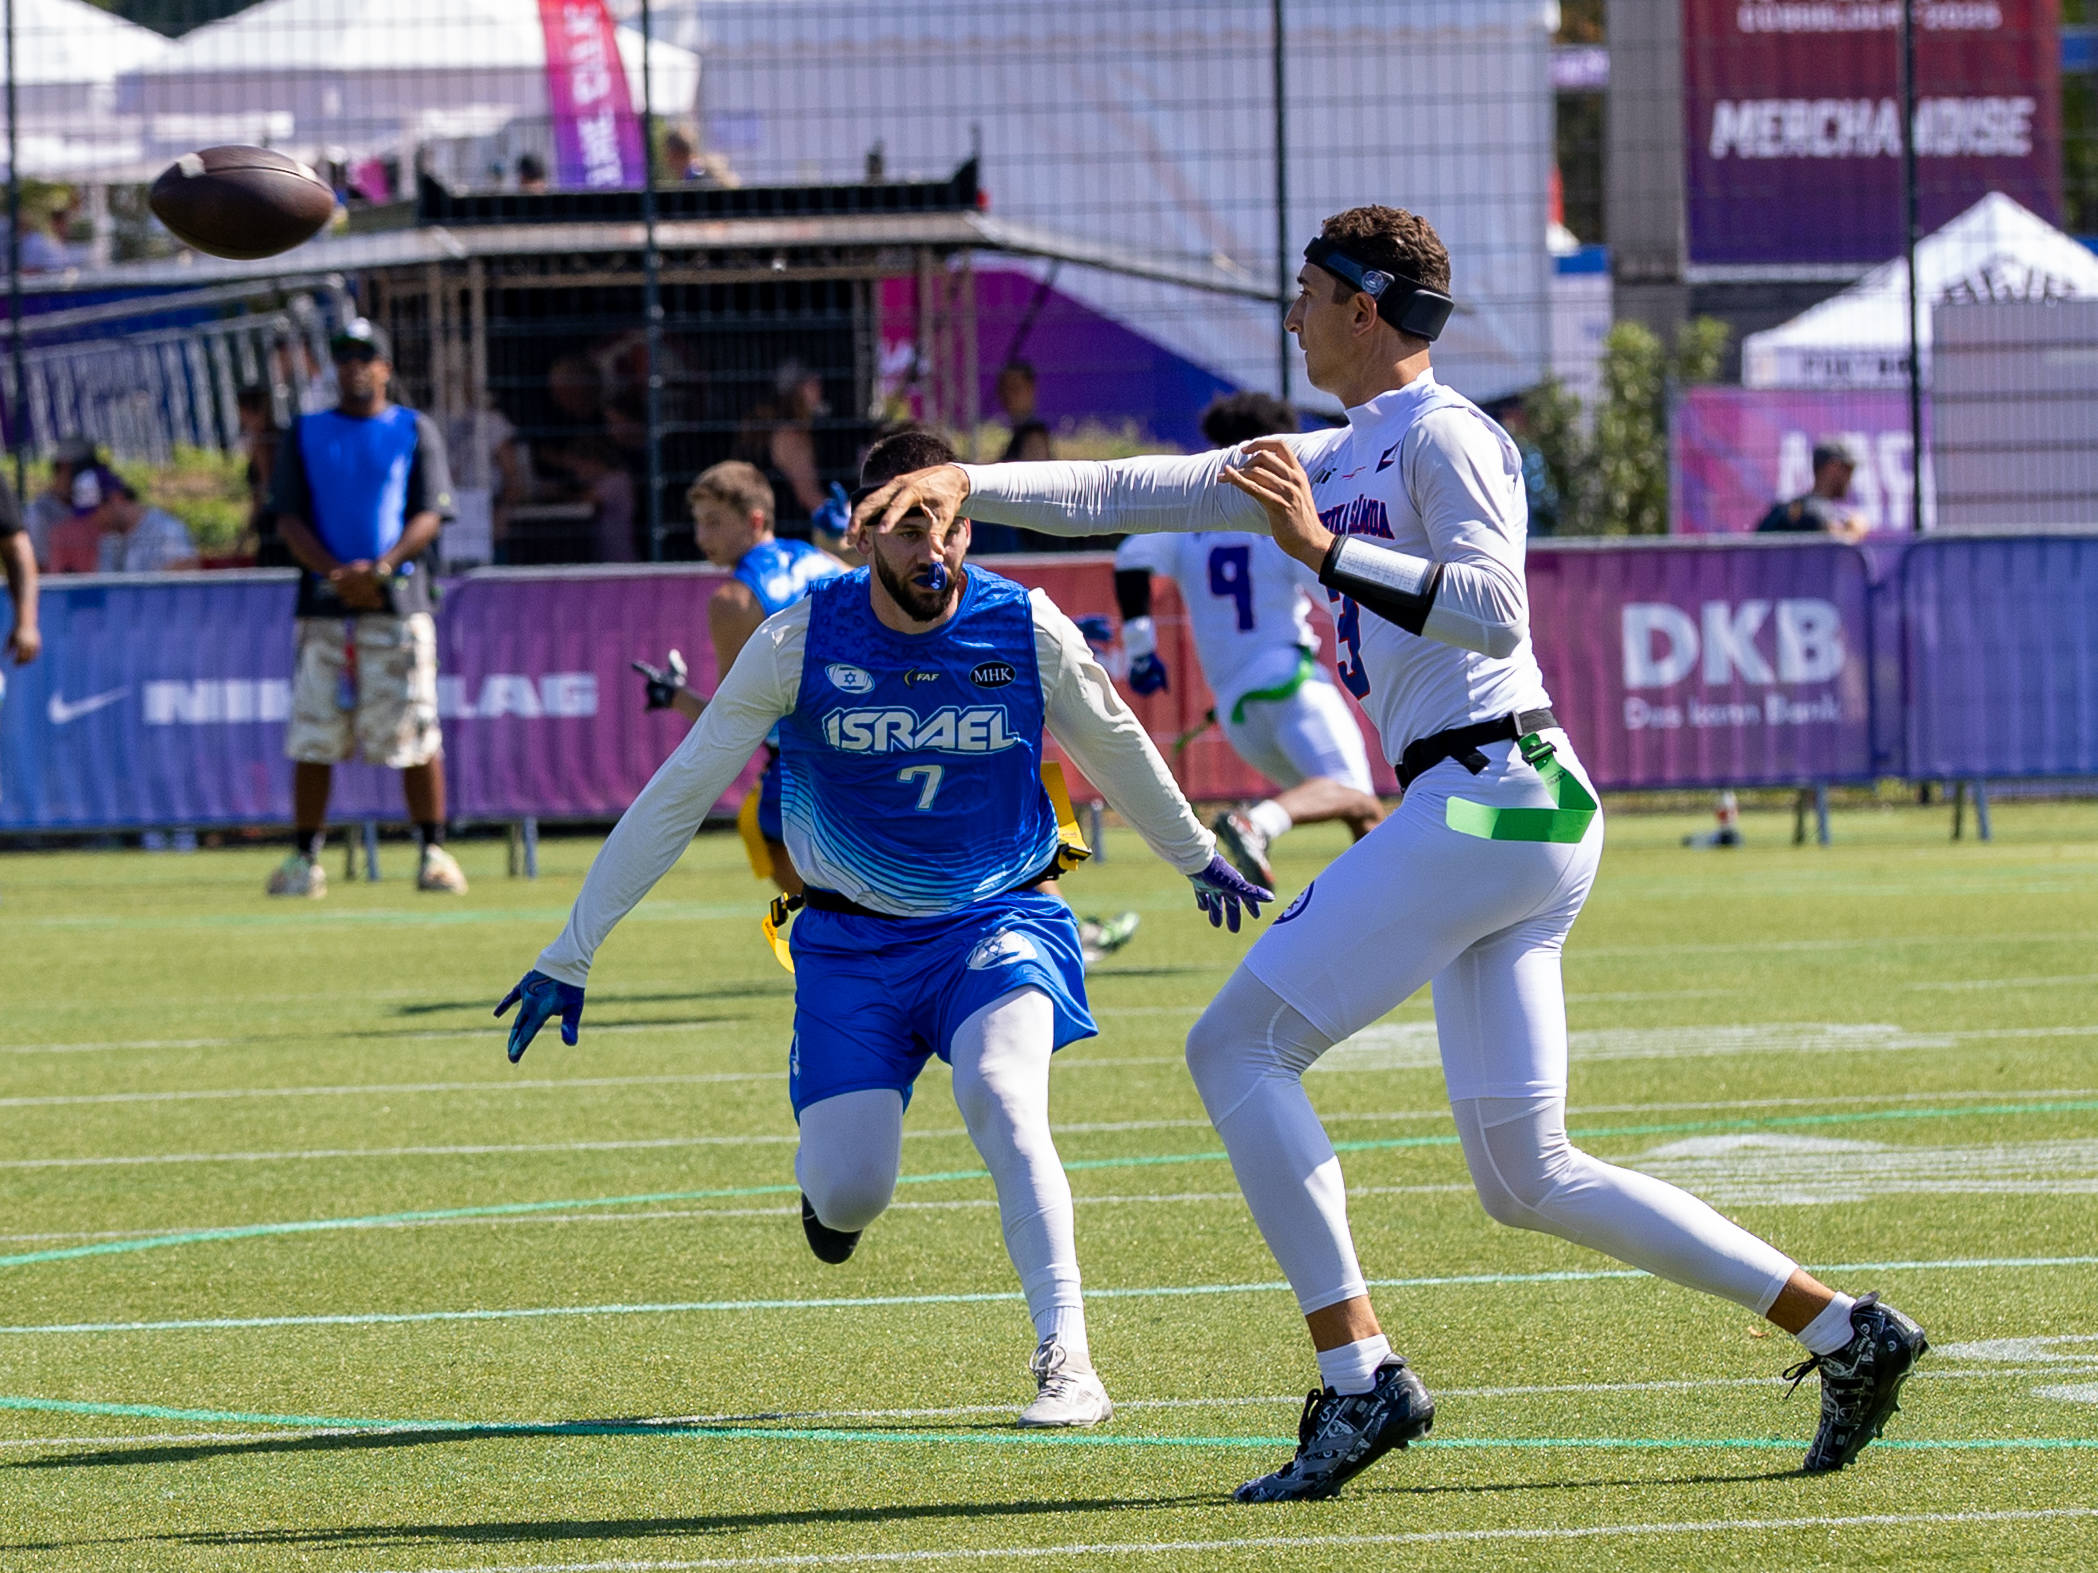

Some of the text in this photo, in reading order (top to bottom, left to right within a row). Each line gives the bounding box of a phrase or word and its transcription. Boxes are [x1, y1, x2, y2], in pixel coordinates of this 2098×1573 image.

[1208, 546, 1256, 633] 9
[1621, 598, 1845, 690] DKB
[436, 672, 598, 720] LAG
[973, 667, 1012, 683] MHK
[823, 705, 1020, 755] ISRAEL
[896, 764, 945, 812] 7
